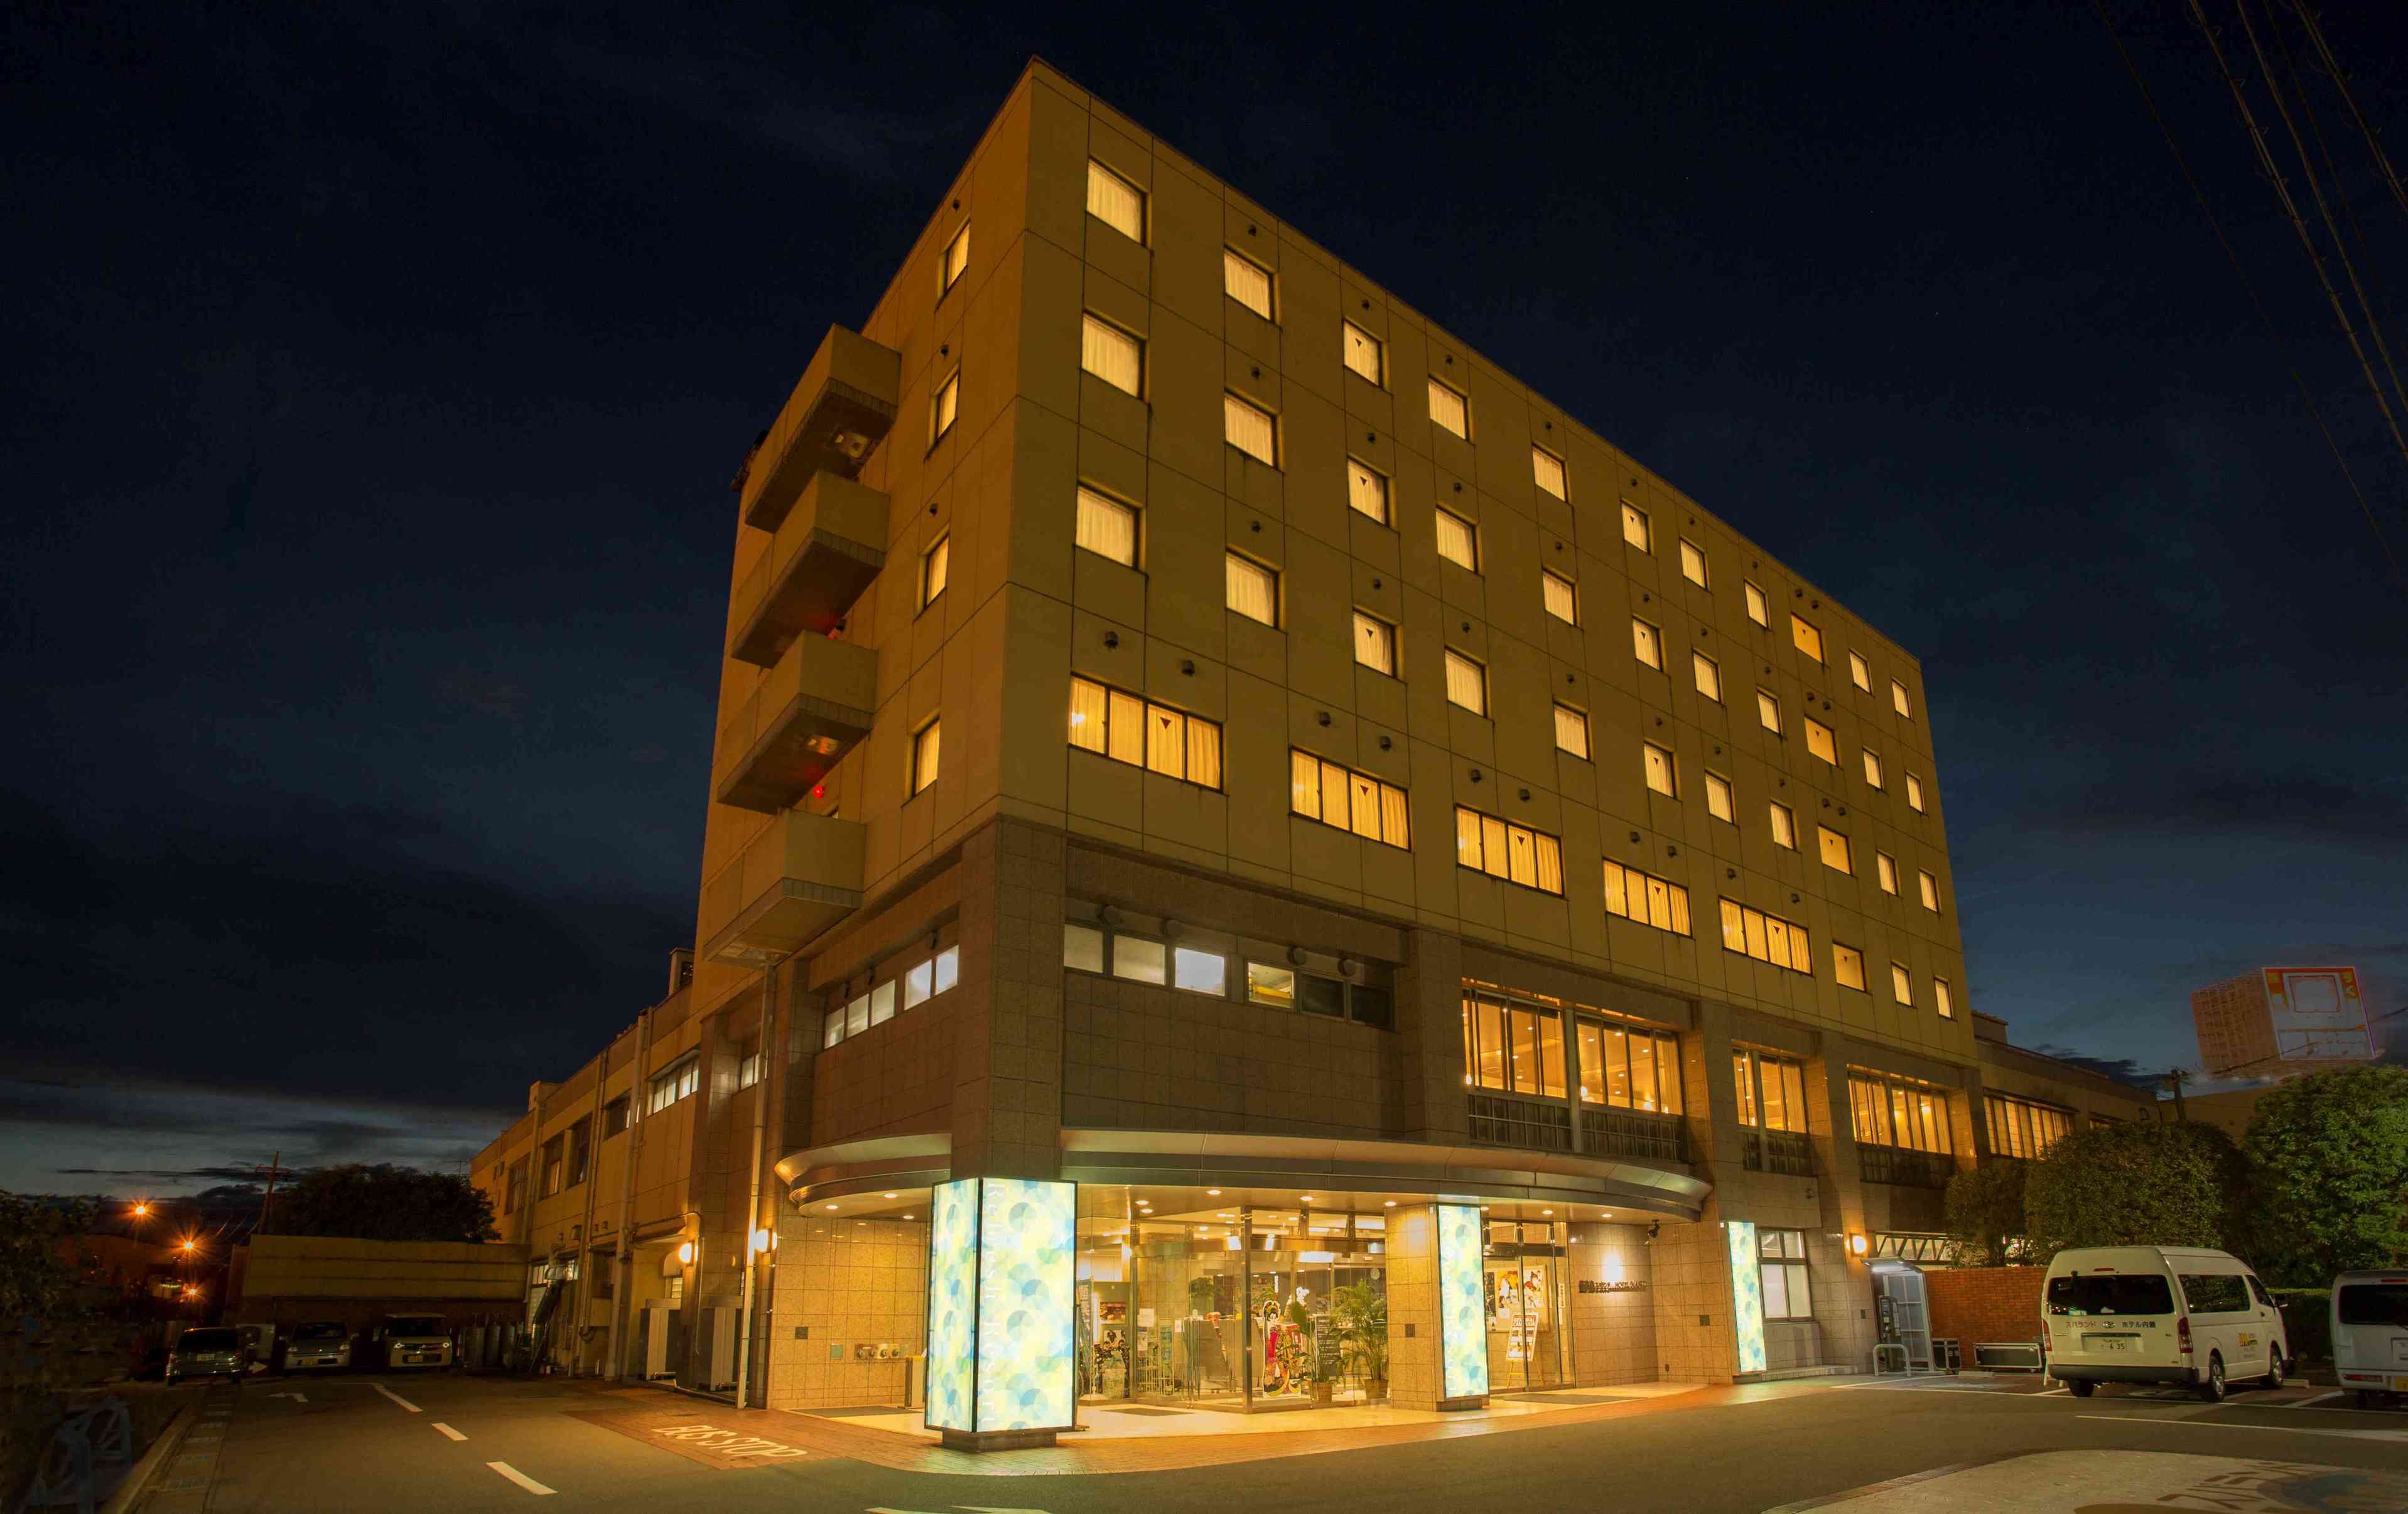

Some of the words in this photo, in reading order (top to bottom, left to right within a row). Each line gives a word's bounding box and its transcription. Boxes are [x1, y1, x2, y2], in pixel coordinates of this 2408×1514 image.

[981, 1322, 1000, 1427] Resort
[651, 1425, 737, 1440] BUS
[696, 1437, 808, 1457] STOP
